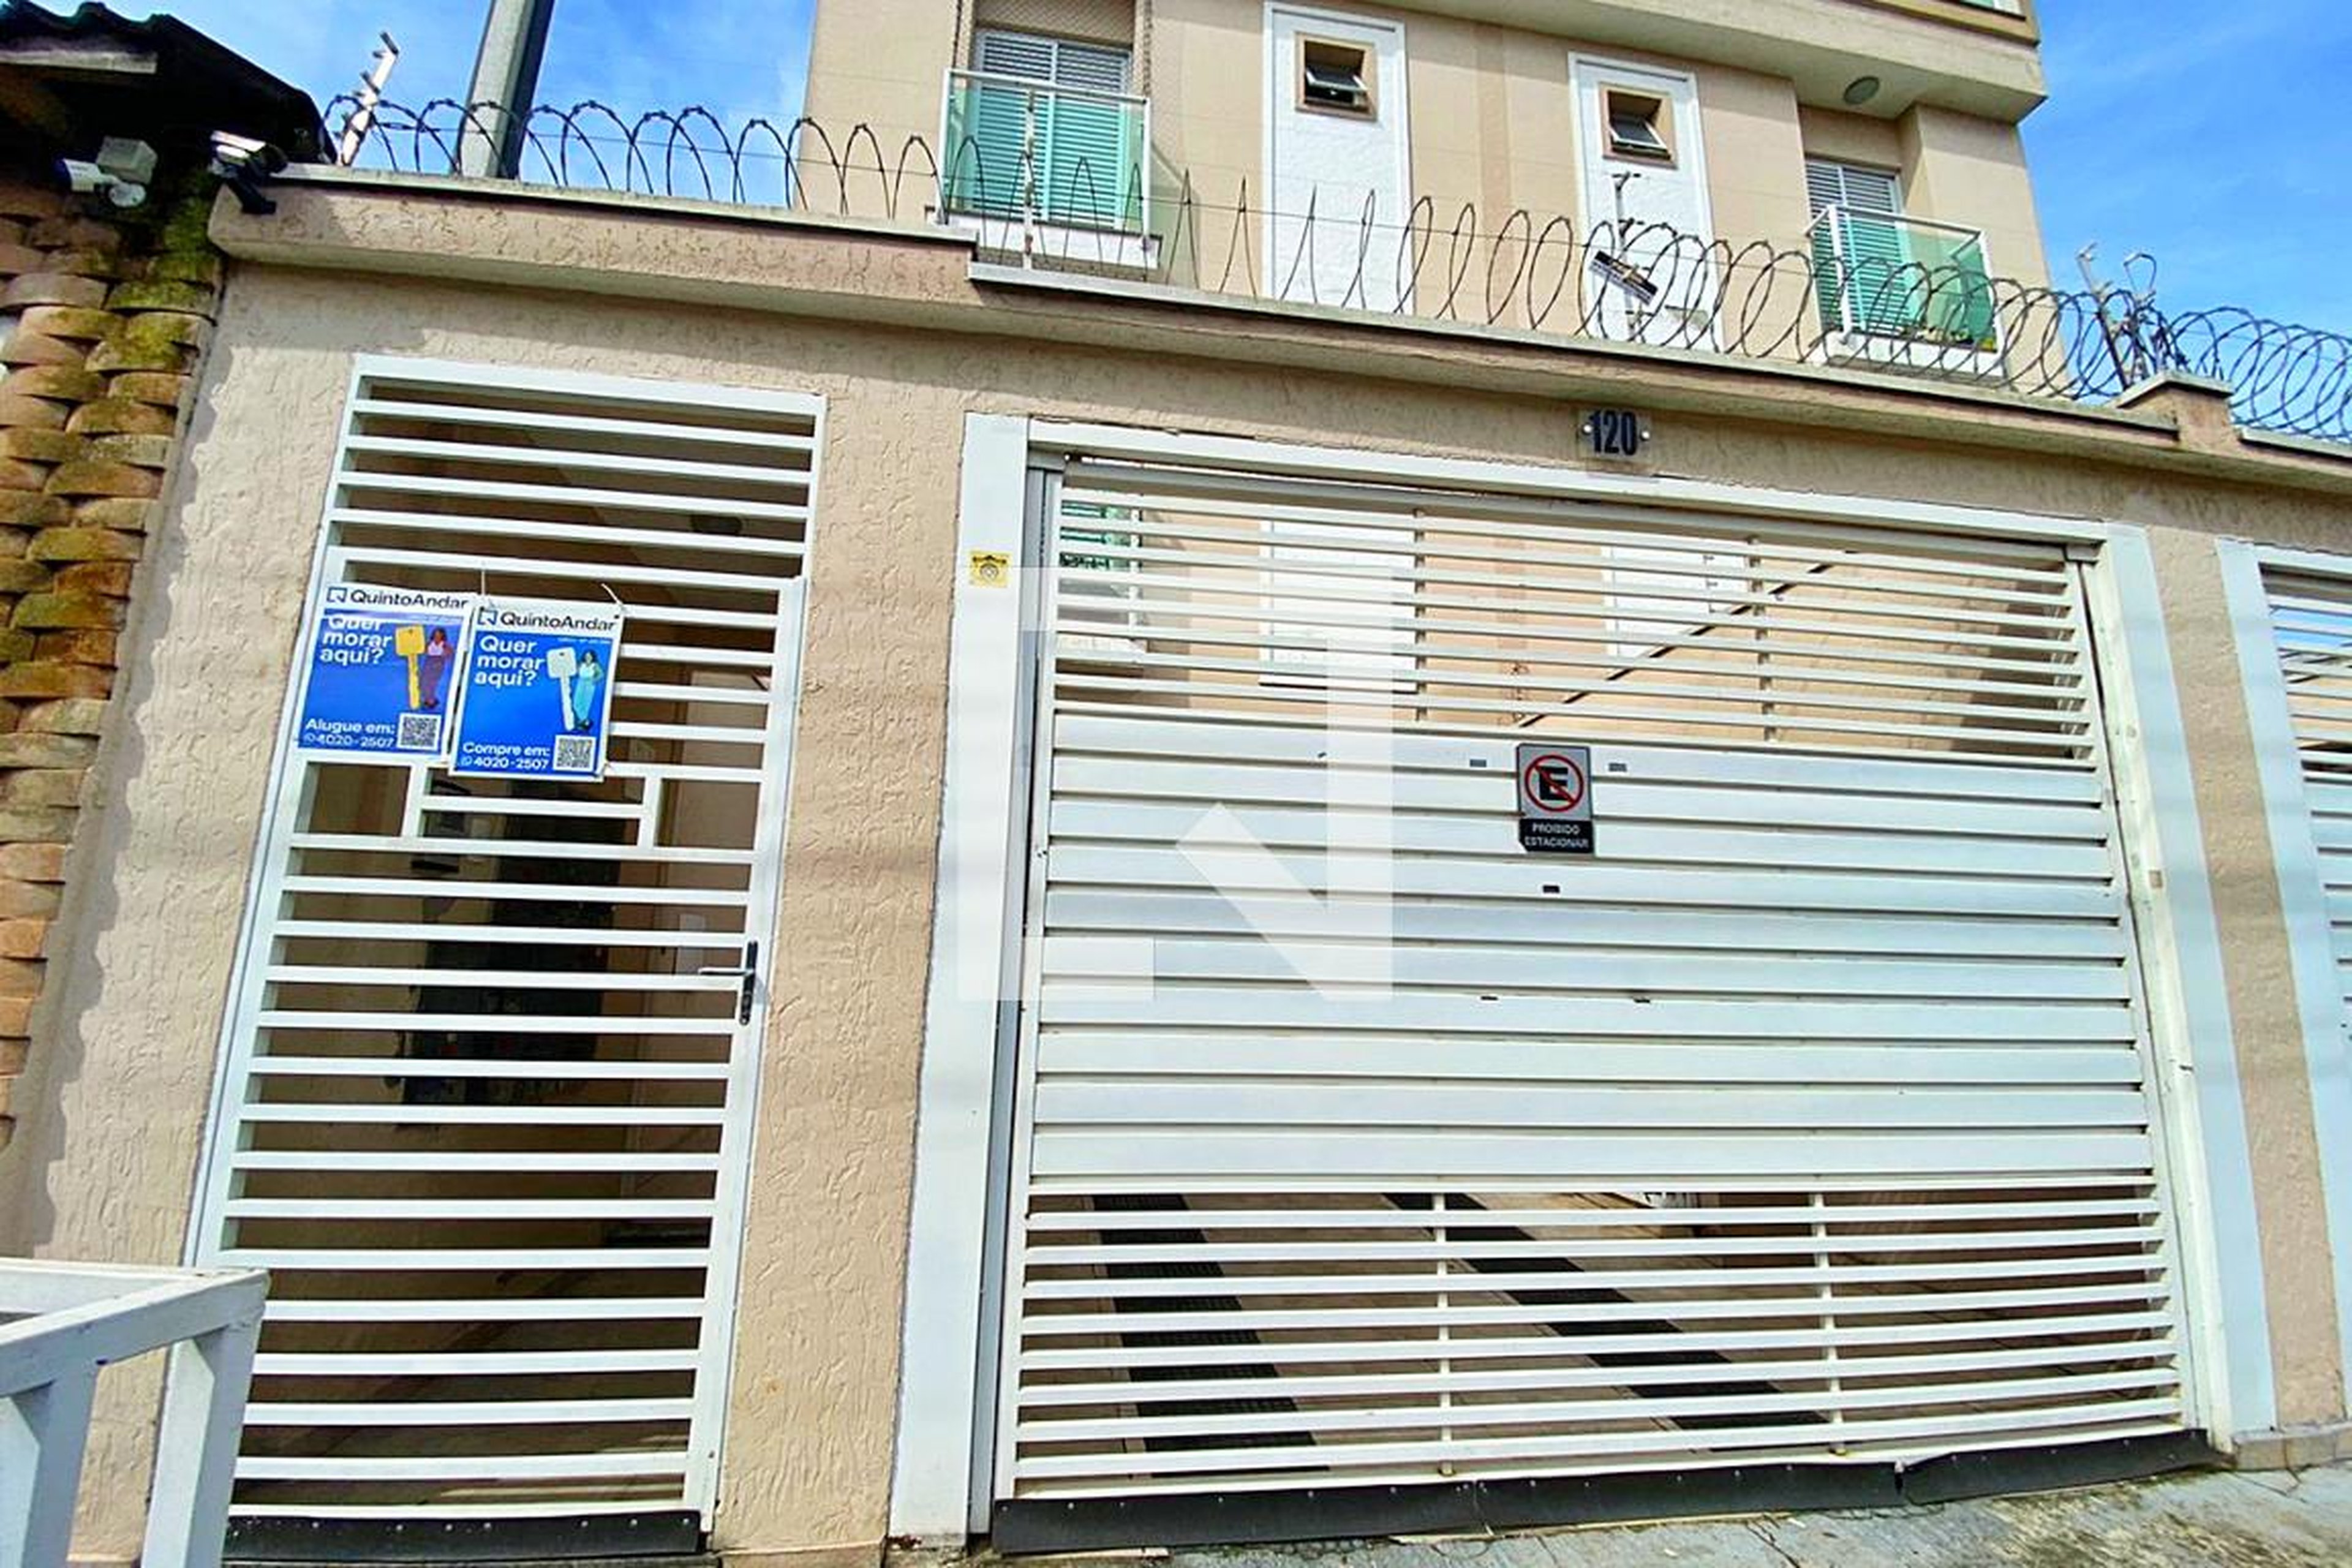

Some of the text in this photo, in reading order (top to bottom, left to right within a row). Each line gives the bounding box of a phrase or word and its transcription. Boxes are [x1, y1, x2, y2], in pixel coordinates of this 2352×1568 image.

[1589, 410, 1637, 455] 120
[350, 589, 469, 609] QuintoAndar
[500, 612, 615, 631] QuintoAndar
[323, 631, 392, 648] morar
[480, 635, 537, 654] Quer
[320, 647, 385, 665] aqui?
[477, 653, 546, 670] morar
[475, 669, 537, 690] aqui?
[305, 718, 396, 734] Alugue em:
[462, 742, 550, 756] Compre em:
[1532, 823, 1580, 835] PROIBIDO
[1524, 836, 1589, 848] ESTACIONAR
